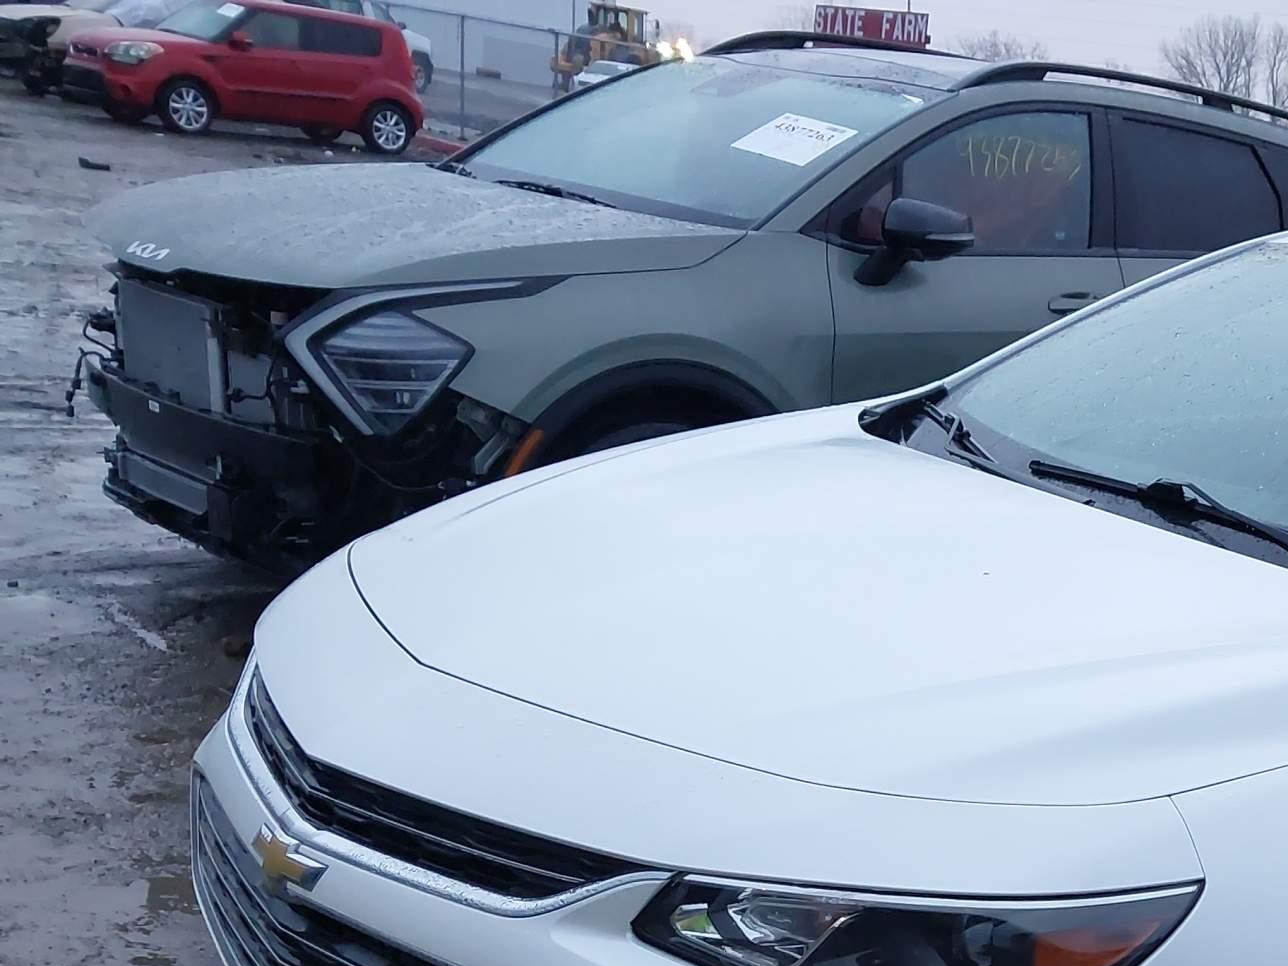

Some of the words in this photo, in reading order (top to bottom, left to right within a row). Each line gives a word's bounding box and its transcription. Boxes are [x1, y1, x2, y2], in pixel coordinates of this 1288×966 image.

[815, 7, 865, 37] STATE
[881, 12, 928, 43] FARM
[126, 240, 170, 260] KIA
